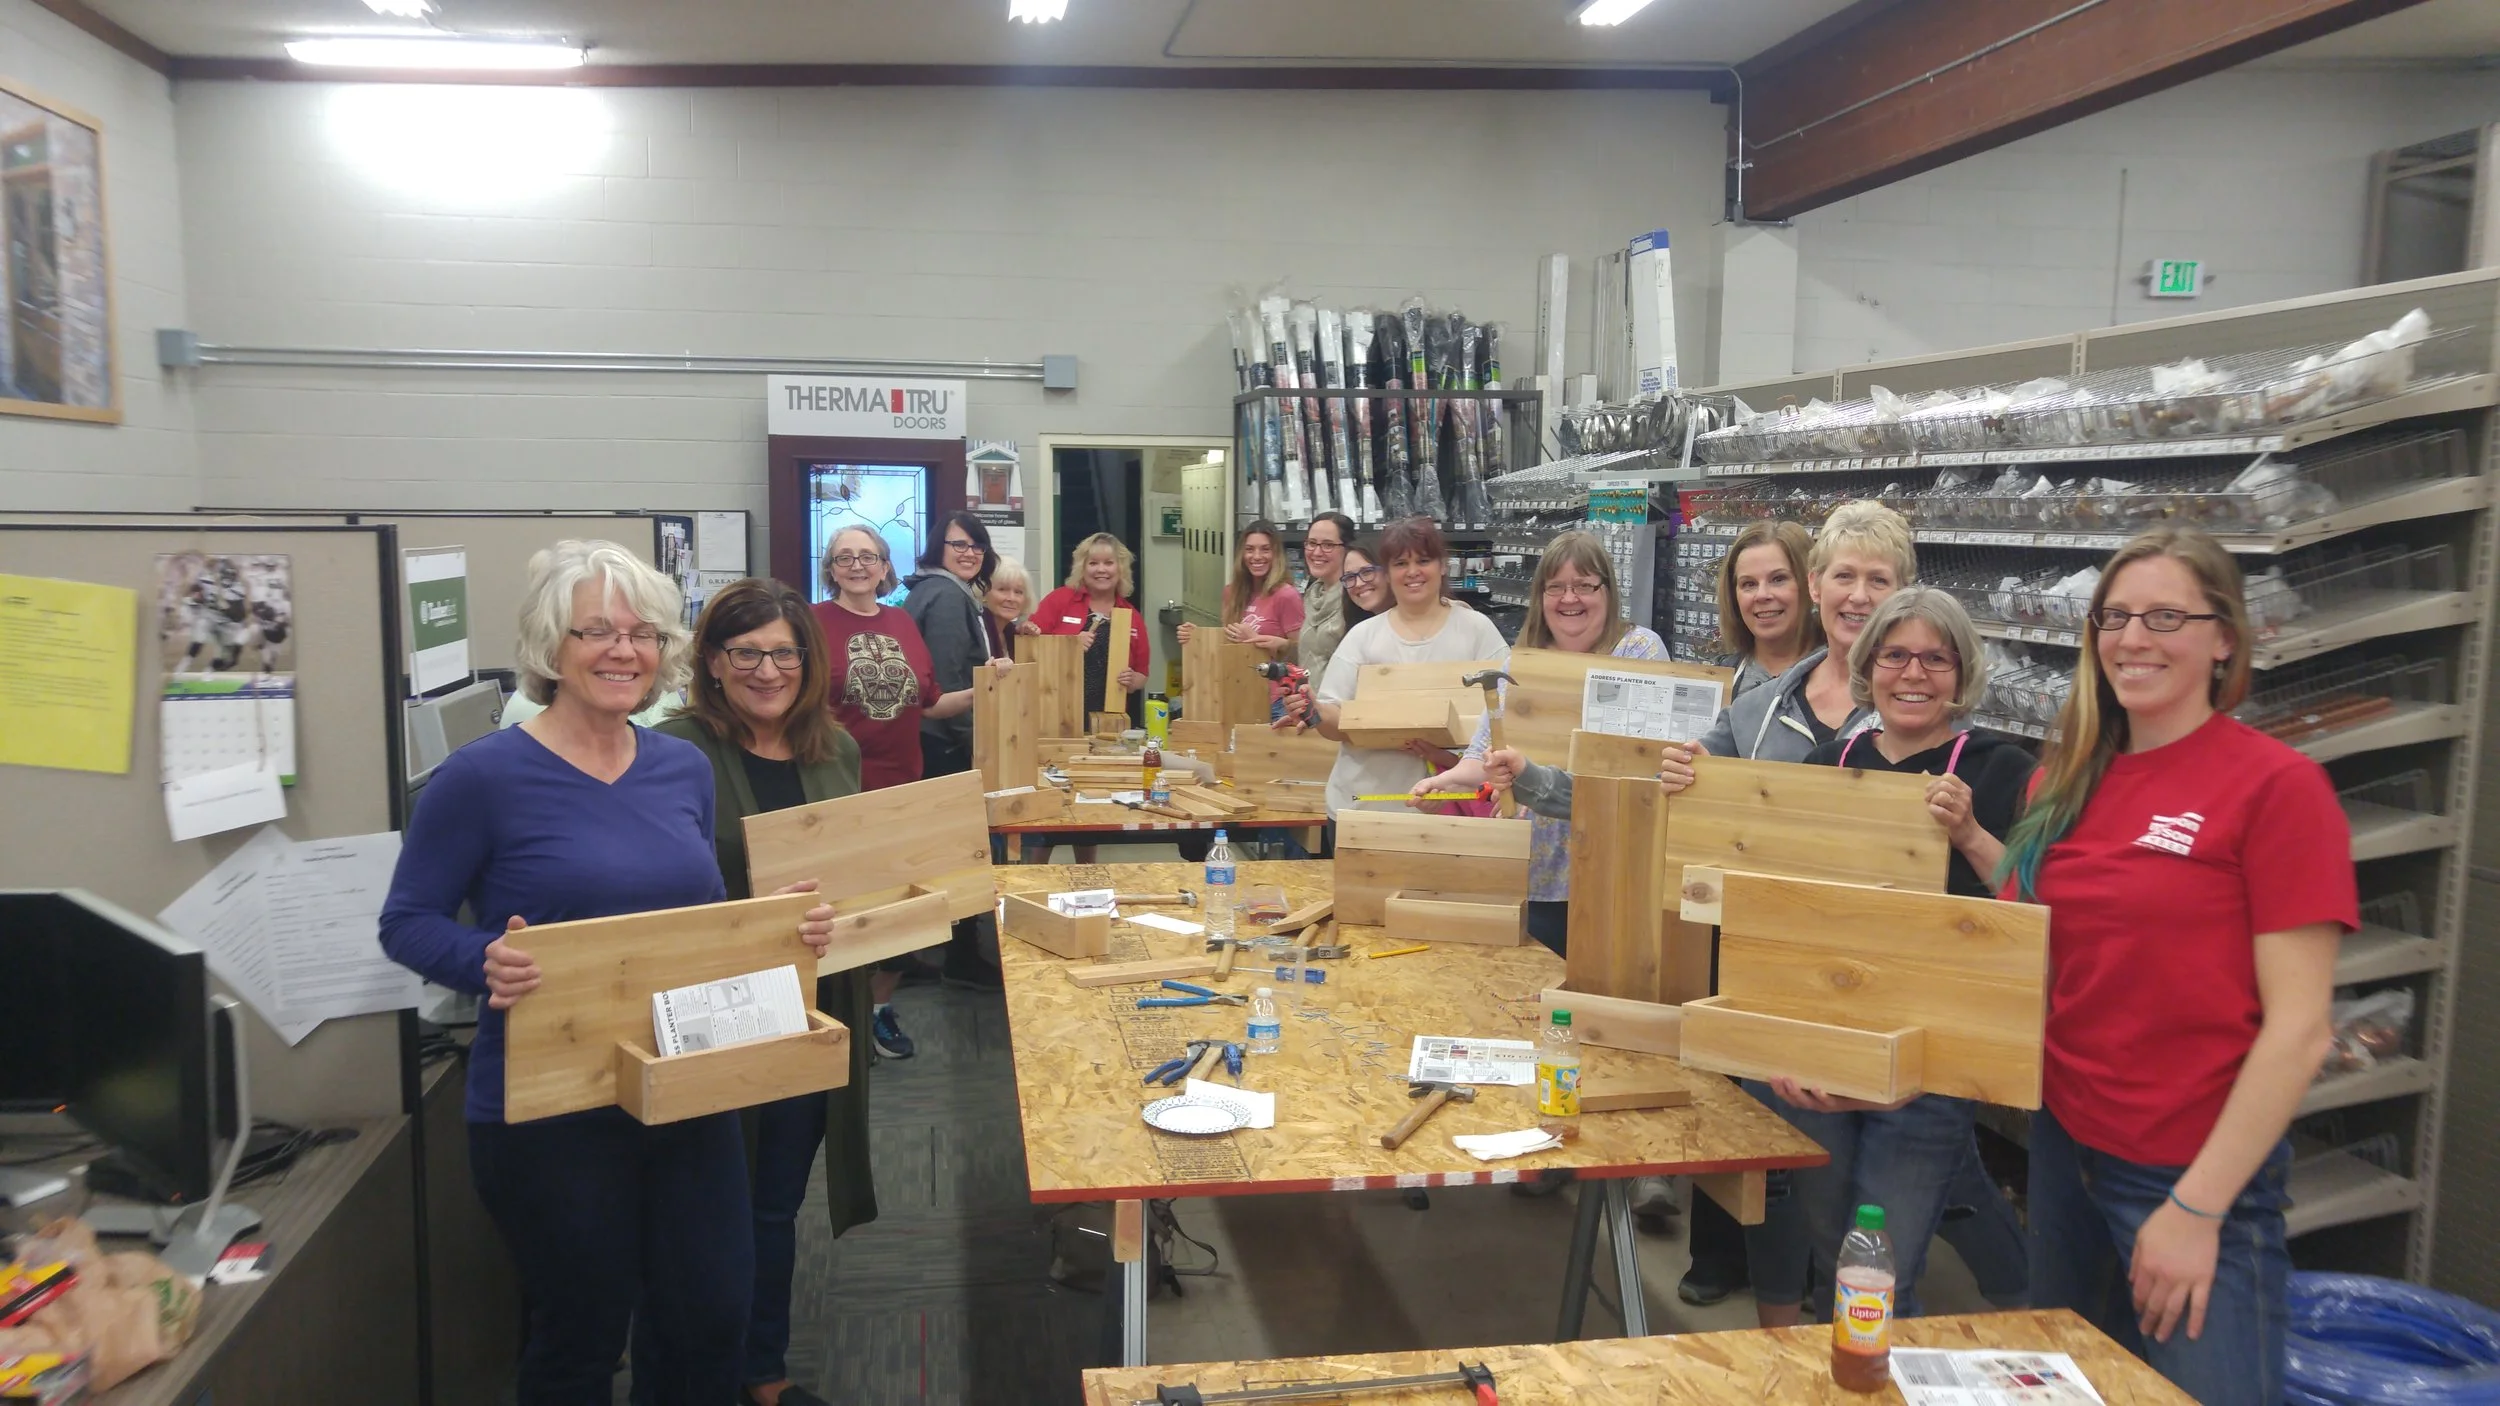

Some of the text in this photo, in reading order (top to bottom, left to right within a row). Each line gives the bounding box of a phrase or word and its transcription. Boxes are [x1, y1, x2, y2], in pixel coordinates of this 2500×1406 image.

[2159, 260, 2198, 292] EXIT
[784, 385, 889, 413] THERMA
[893, 416, 946, 430] DOORS
[1590, 674, 1616, 682] ADDRESS
[1616, 677, 1643, 685] PLANTER
[665, 1006, 679, 1044] PLANTER
[1851, 1307, 1881, 1320] Lipton
